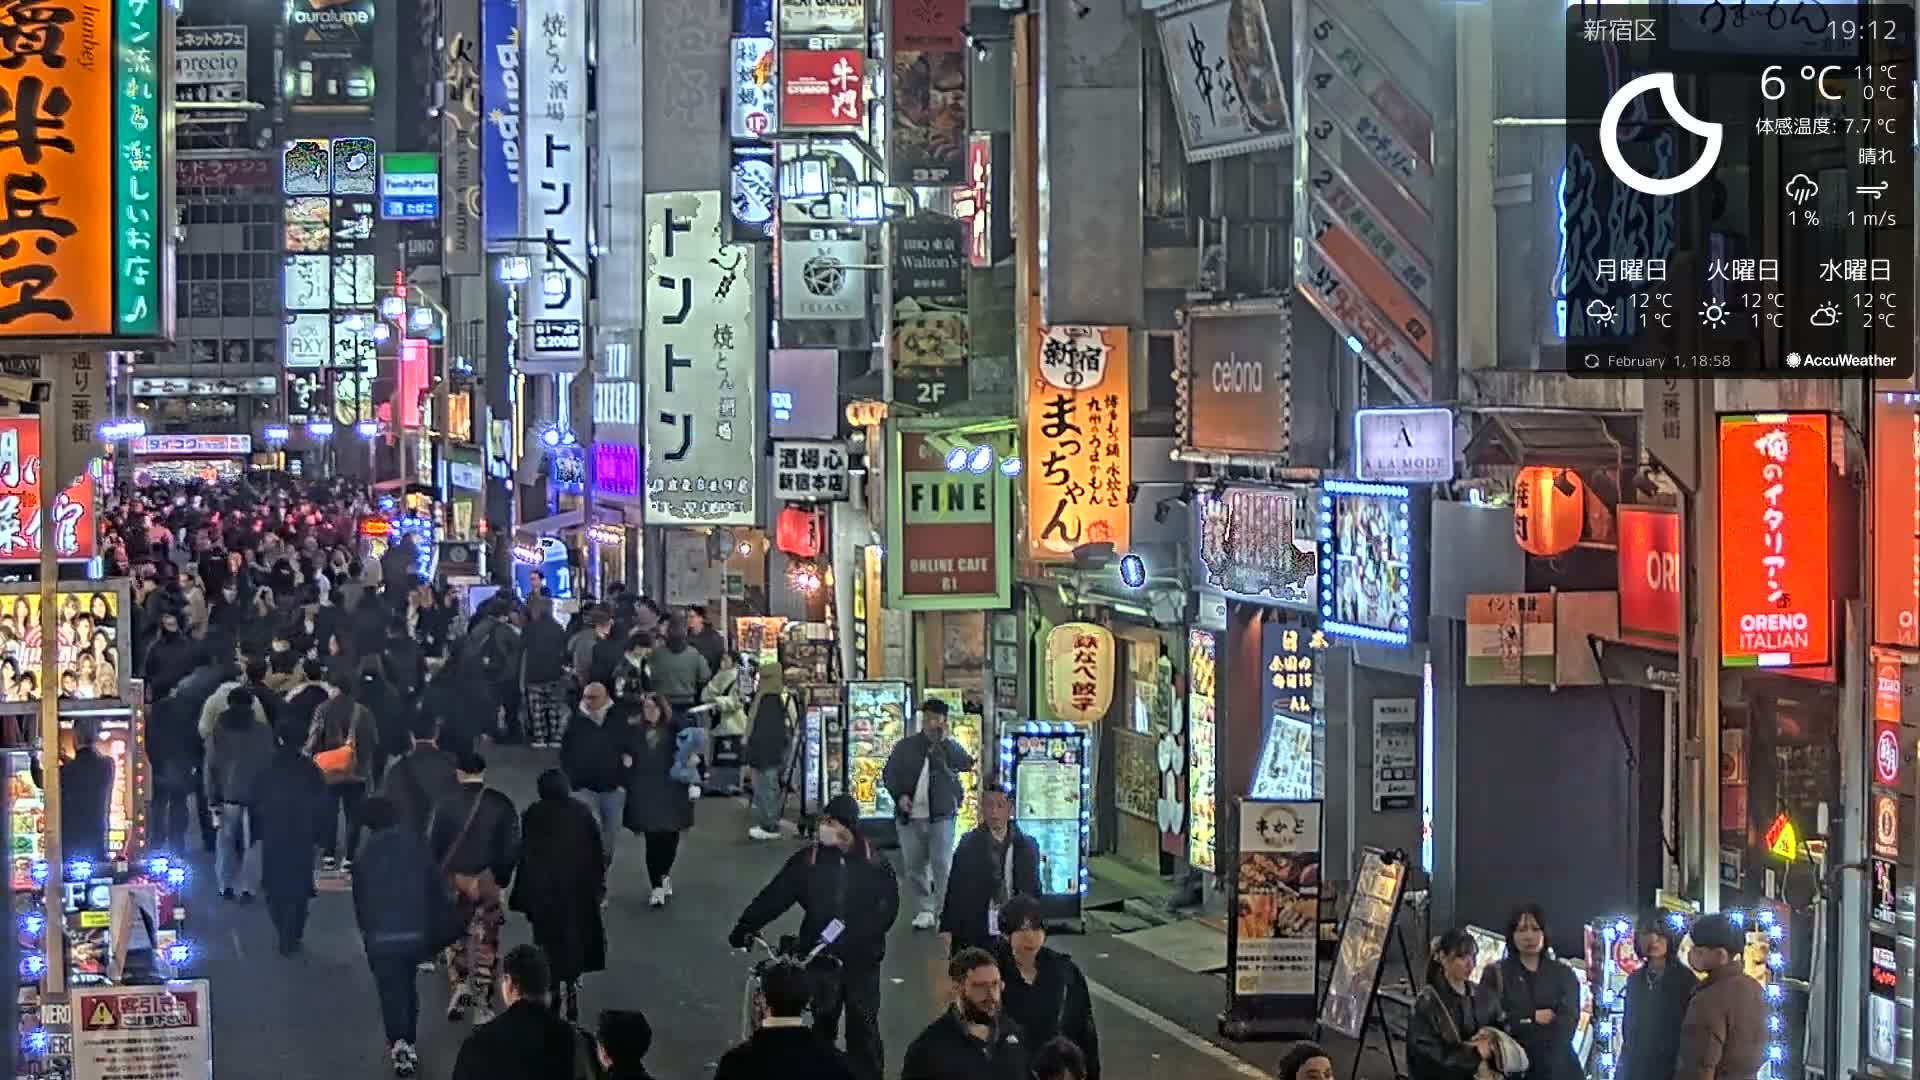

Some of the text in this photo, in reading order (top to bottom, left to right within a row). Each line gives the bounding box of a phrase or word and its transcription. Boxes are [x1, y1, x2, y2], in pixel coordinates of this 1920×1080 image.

[1314, 20, 1334, 41] 5
[830, 57, 859, 119] 牛門
[1314, 72, 1333, 89] 4
[1314, 120, 1334, 140] 3
[659, 207, 692, 461] トントン
[1212, 352, 1263, 392] celona
[917, 383, 946, 402] 2F
[779, 448, 844, 470] 酒場心
[1041, 394, 1084, 544] まっちゃん
[779, 472, 843, 492] 新宿本店
[910, 483, 986, 511] FINE
[1755, 428, 1789, 602] 俺のイタリアン
[909, 558, 989, 573] ONLINE CAFE
[1740, 612, 1808, 632] ORENO
[1739, 631, 1809, 650] ITALIAN
